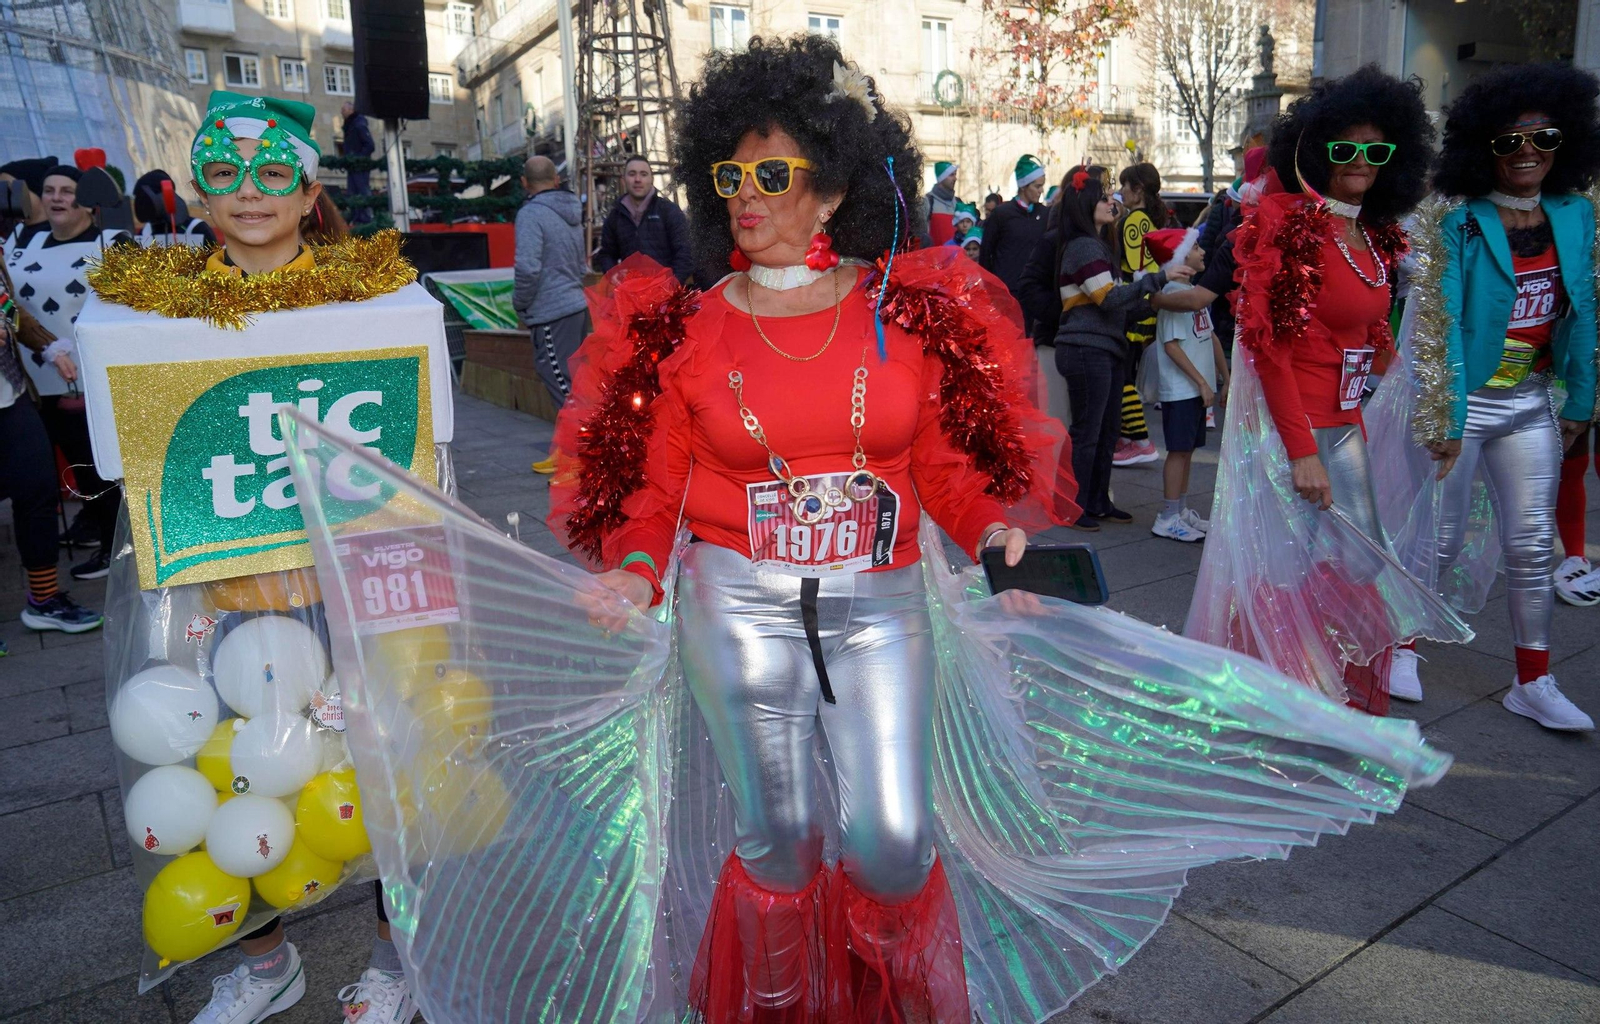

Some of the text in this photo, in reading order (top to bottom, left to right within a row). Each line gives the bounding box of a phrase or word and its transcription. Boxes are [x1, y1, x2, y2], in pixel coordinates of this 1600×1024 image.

[1516, 281, 1551, 295] vigo
[1345, 376, 1369, 399] 197
[238, 379, 383, 456] tic
[201, 446, 382, 519] tac
[881, 511, 892, 530] 1976
[373, 541, 416, 552] SILVESTRE
[774, 520, 858, 562] 1976
[362, 548, 425, 570] vigo
[362, 570, 429, 616] 981
[321, 711, 344, 722] Christ
